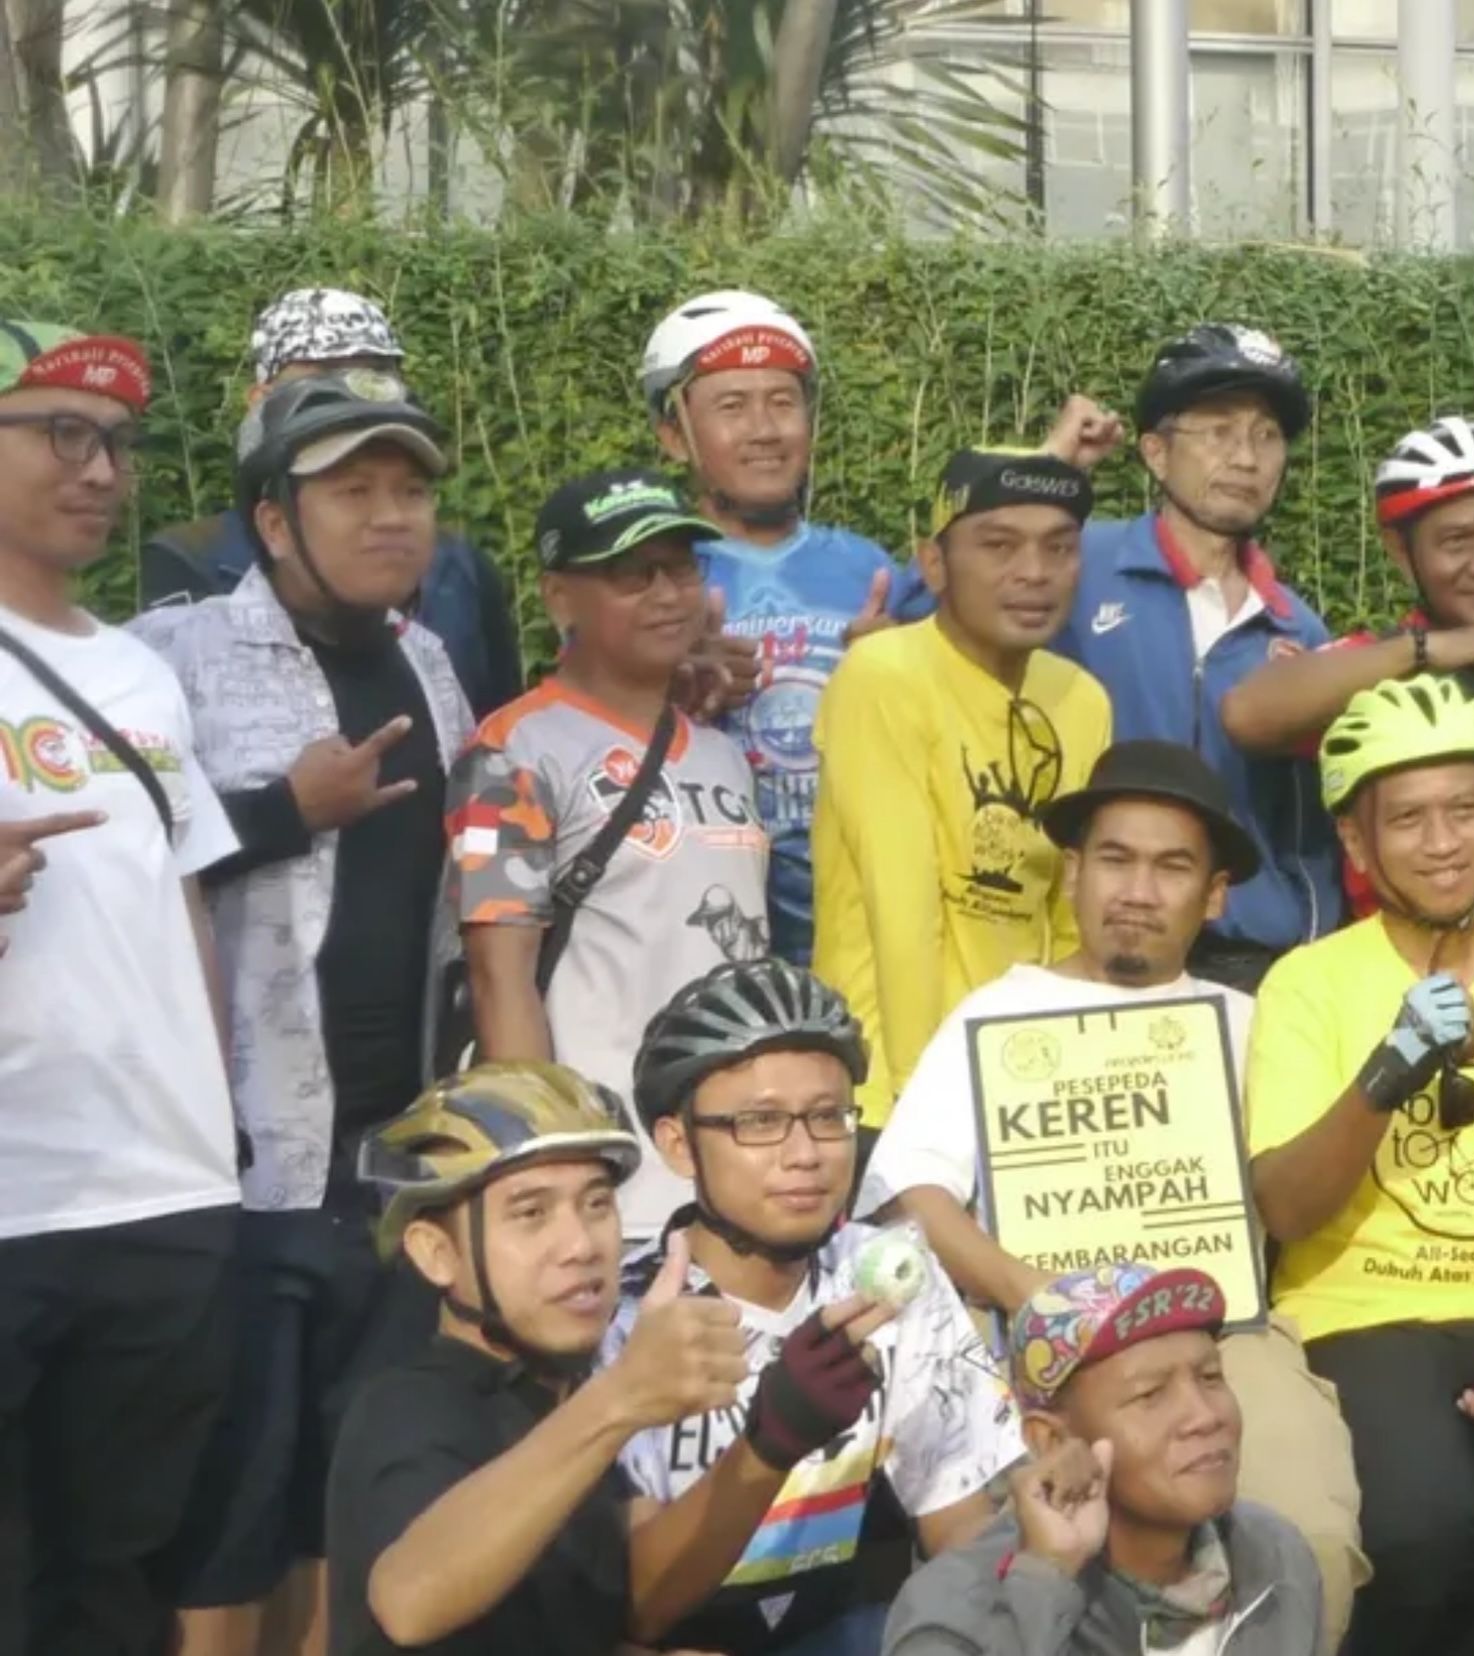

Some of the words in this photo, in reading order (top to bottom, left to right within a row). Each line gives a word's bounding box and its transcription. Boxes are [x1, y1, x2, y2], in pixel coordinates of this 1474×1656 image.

[1053, 1070, 1168, 1097] PESEPEDA
[998, 1088, 1170, 1142] KEREN
[1093, 1139, 1129, 1159] ITU
[1104, 1156, 1206, 1182] ENGGAK
[1024, 1176, 1209, 1220] NYAMPAH
